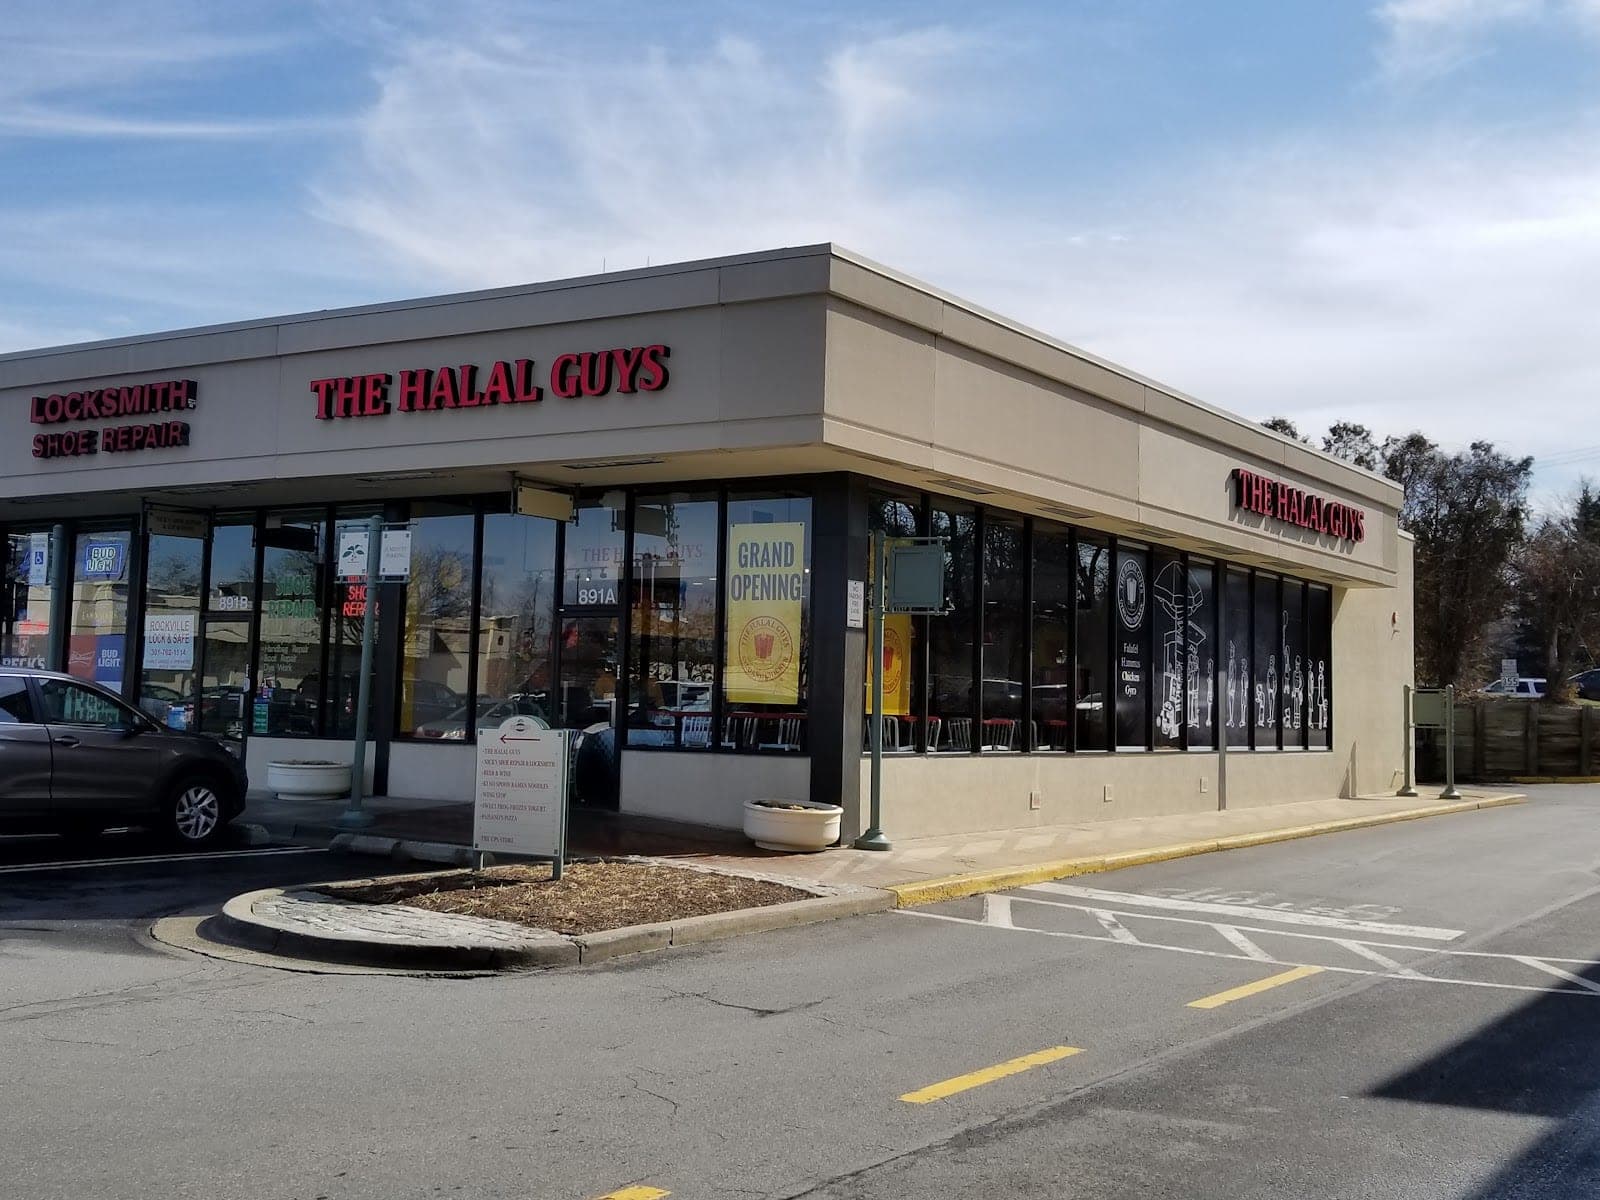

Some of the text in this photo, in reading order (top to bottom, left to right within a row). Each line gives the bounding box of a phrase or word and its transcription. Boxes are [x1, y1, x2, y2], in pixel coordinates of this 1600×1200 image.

[310, 345, 671, 420] THE HALAL GUYS
[30, 380, 197, 424] LOCKSMITH
[32, 421, 190, 458] SHOE REPAIR
[1232, 468, 1365, 543] THE HALAL GUYS
[92, 547, 116, 560] BUD
[738, 541, 795, 569] GRAND
[276, 575, 313, 596] SHOE
[348, 585, 369, 600] SHO
[731, 573, 801, 601] OPENING
[219, 596, 248, 609] 891B
[579, 588, 616, 605] 891A
[267, 600, 317, 619] REPAIR
[150, 620, 190, 631] ROCKVILLE
[149, 633, 167, 644] LOCK
[174, 633, 190, 644] SAFE
[97, 657, 121, 668] LIGHT
[101, 649, 119, 659] BUD
